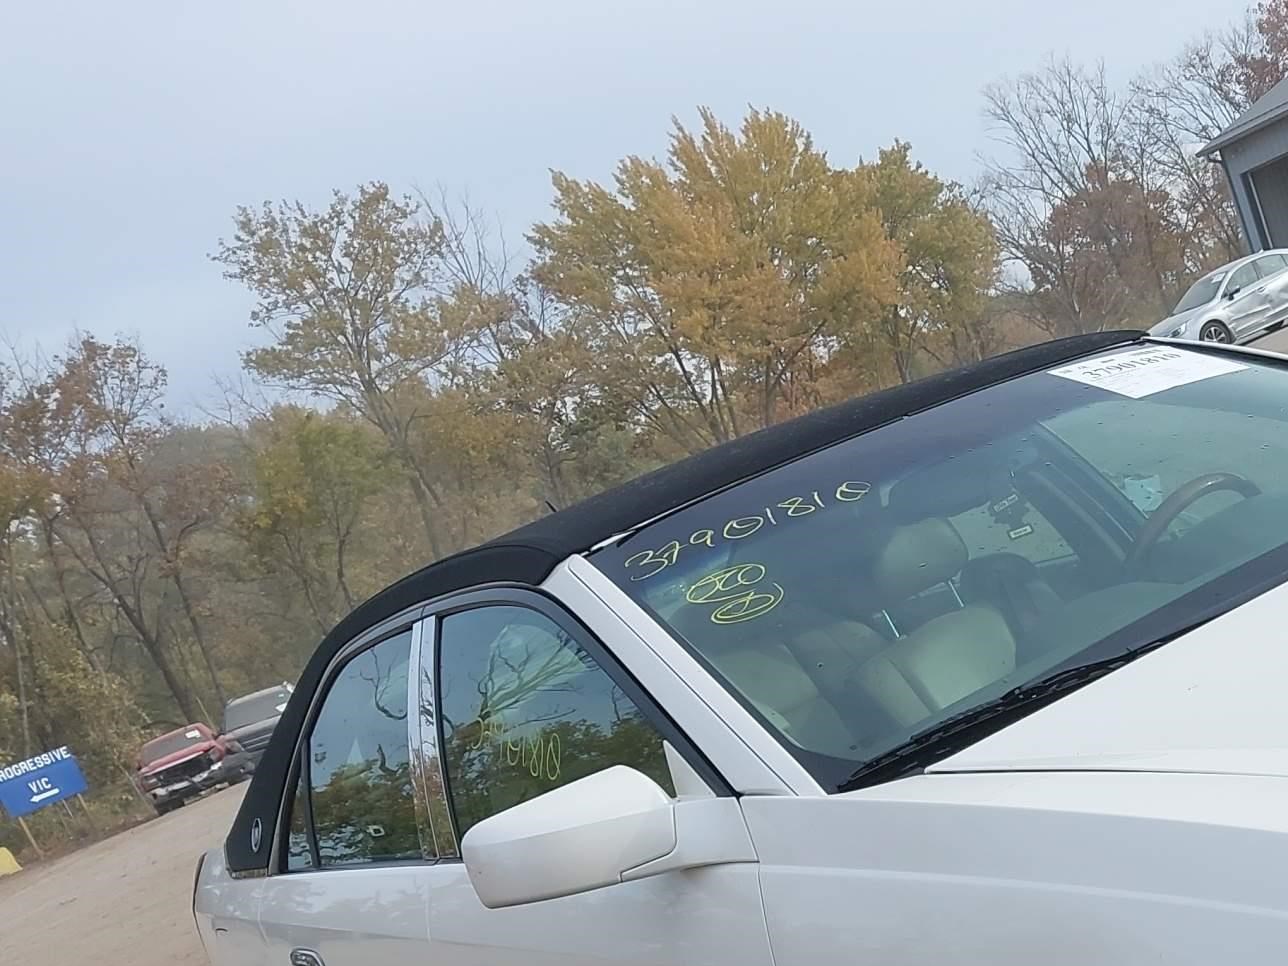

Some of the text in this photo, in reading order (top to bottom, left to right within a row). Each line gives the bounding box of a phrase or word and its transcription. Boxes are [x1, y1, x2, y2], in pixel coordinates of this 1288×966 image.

[1081, 351, 1182, 380] 37901810
[624, 481, 872, 581] 37901810
[0, 745, 71, 783] ROGRESSIVE
[28, 777, 52, 794] VIC
